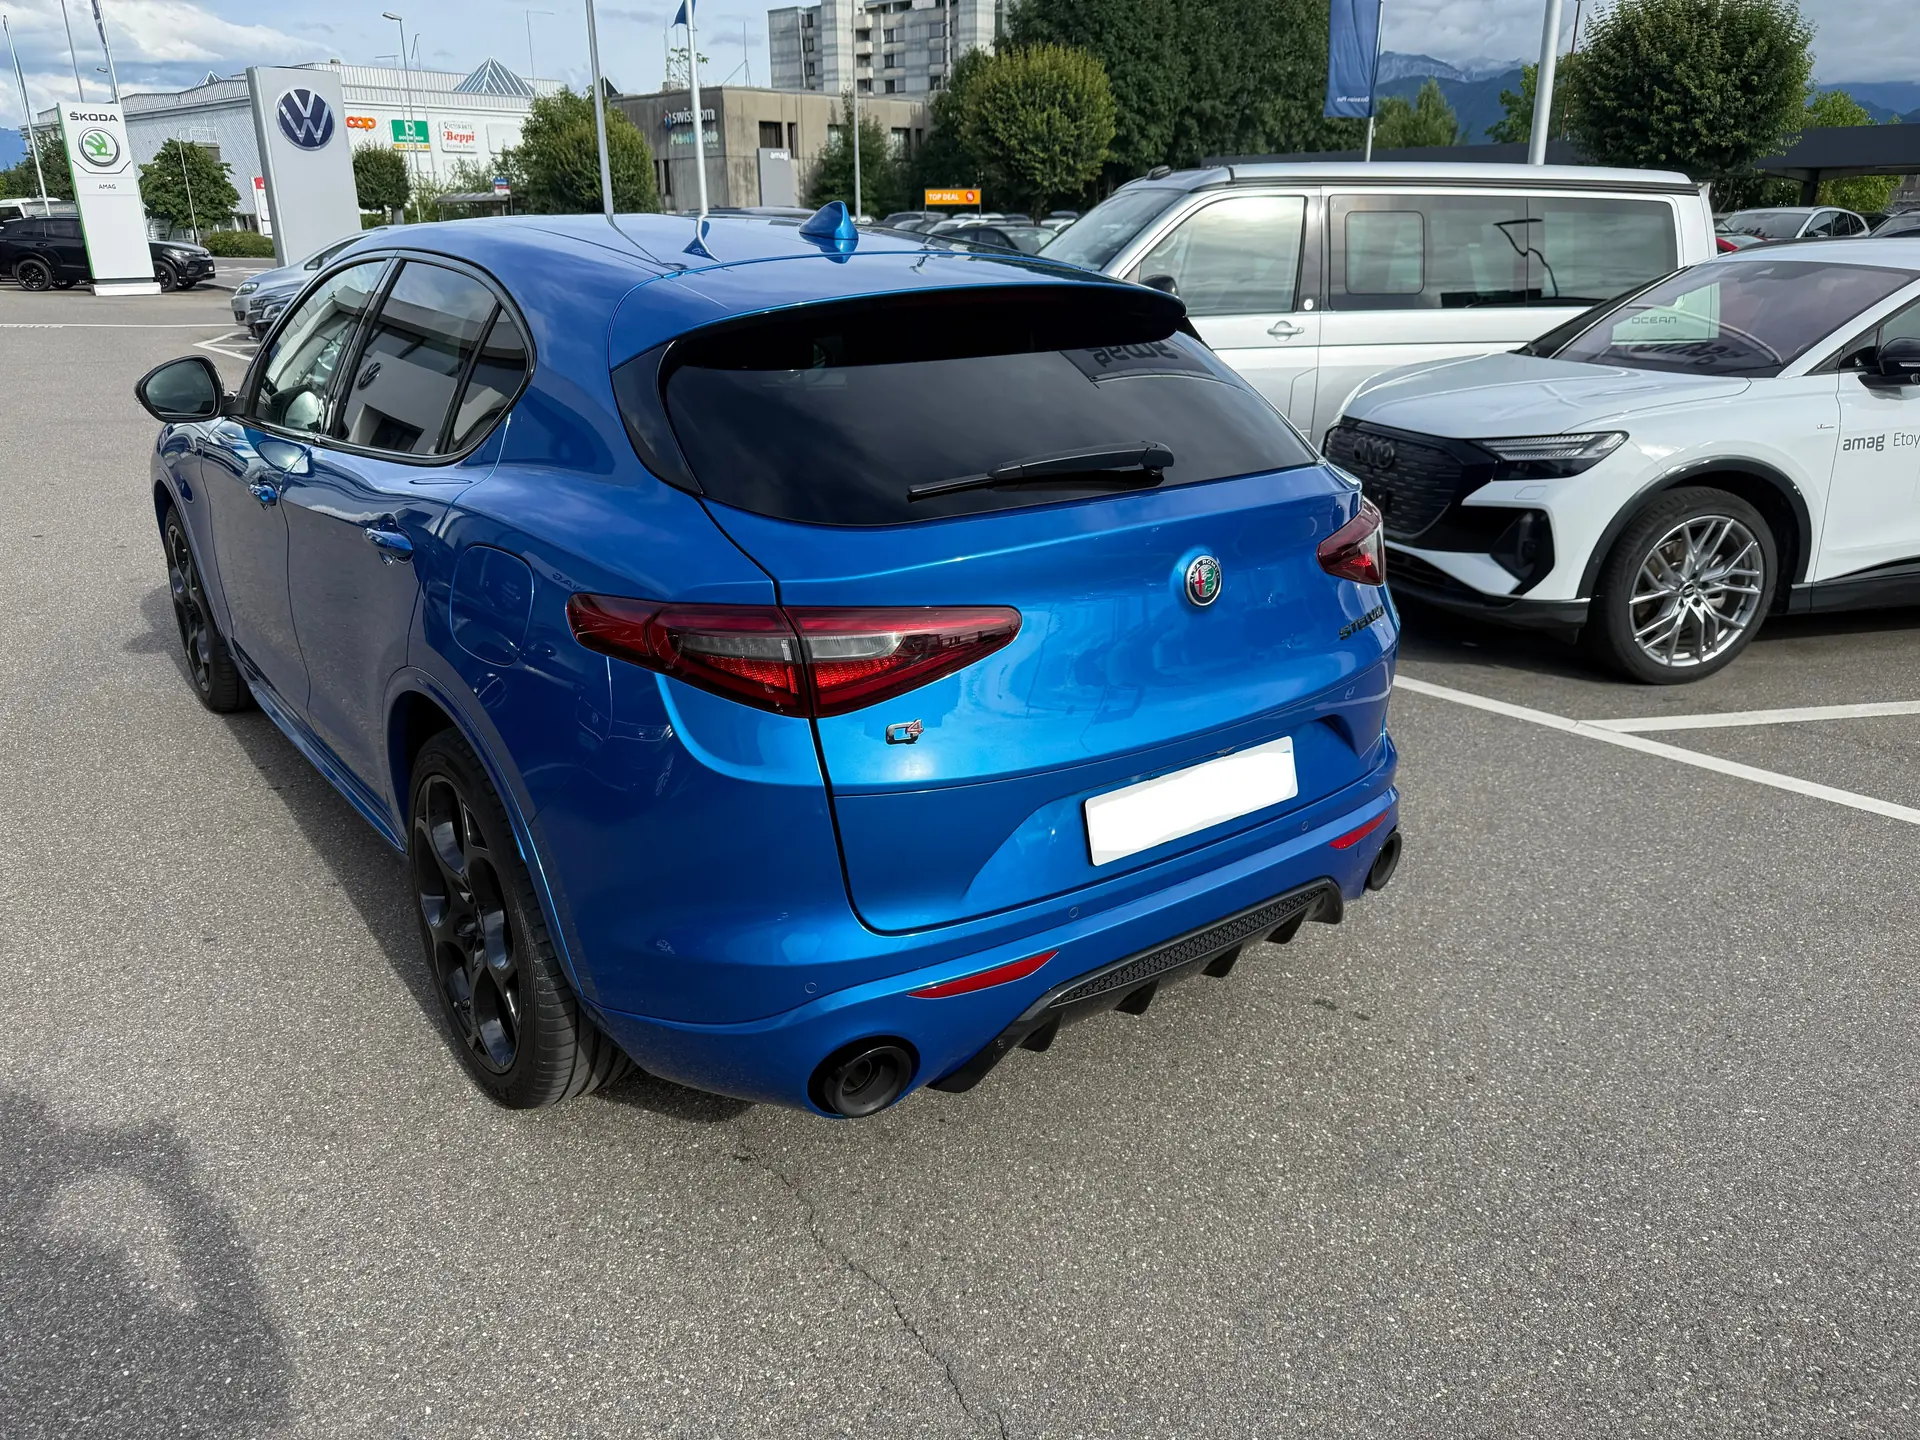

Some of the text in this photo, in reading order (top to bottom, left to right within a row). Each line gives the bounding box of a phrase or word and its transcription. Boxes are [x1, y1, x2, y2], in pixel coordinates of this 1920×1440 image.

[69, 110, 118, 122] ŠKODA
[672, 107, 716, 124] swissom
[346, 116, 376, 132] oop
[443, 131, 475, 143] Beppi
[928, 193, 942, 201] TOP
[942, 193, 960, 201] DEAL
[1631, 316, 1678, 325] OCEAN
[1842, 433, 1886, 452] amag
